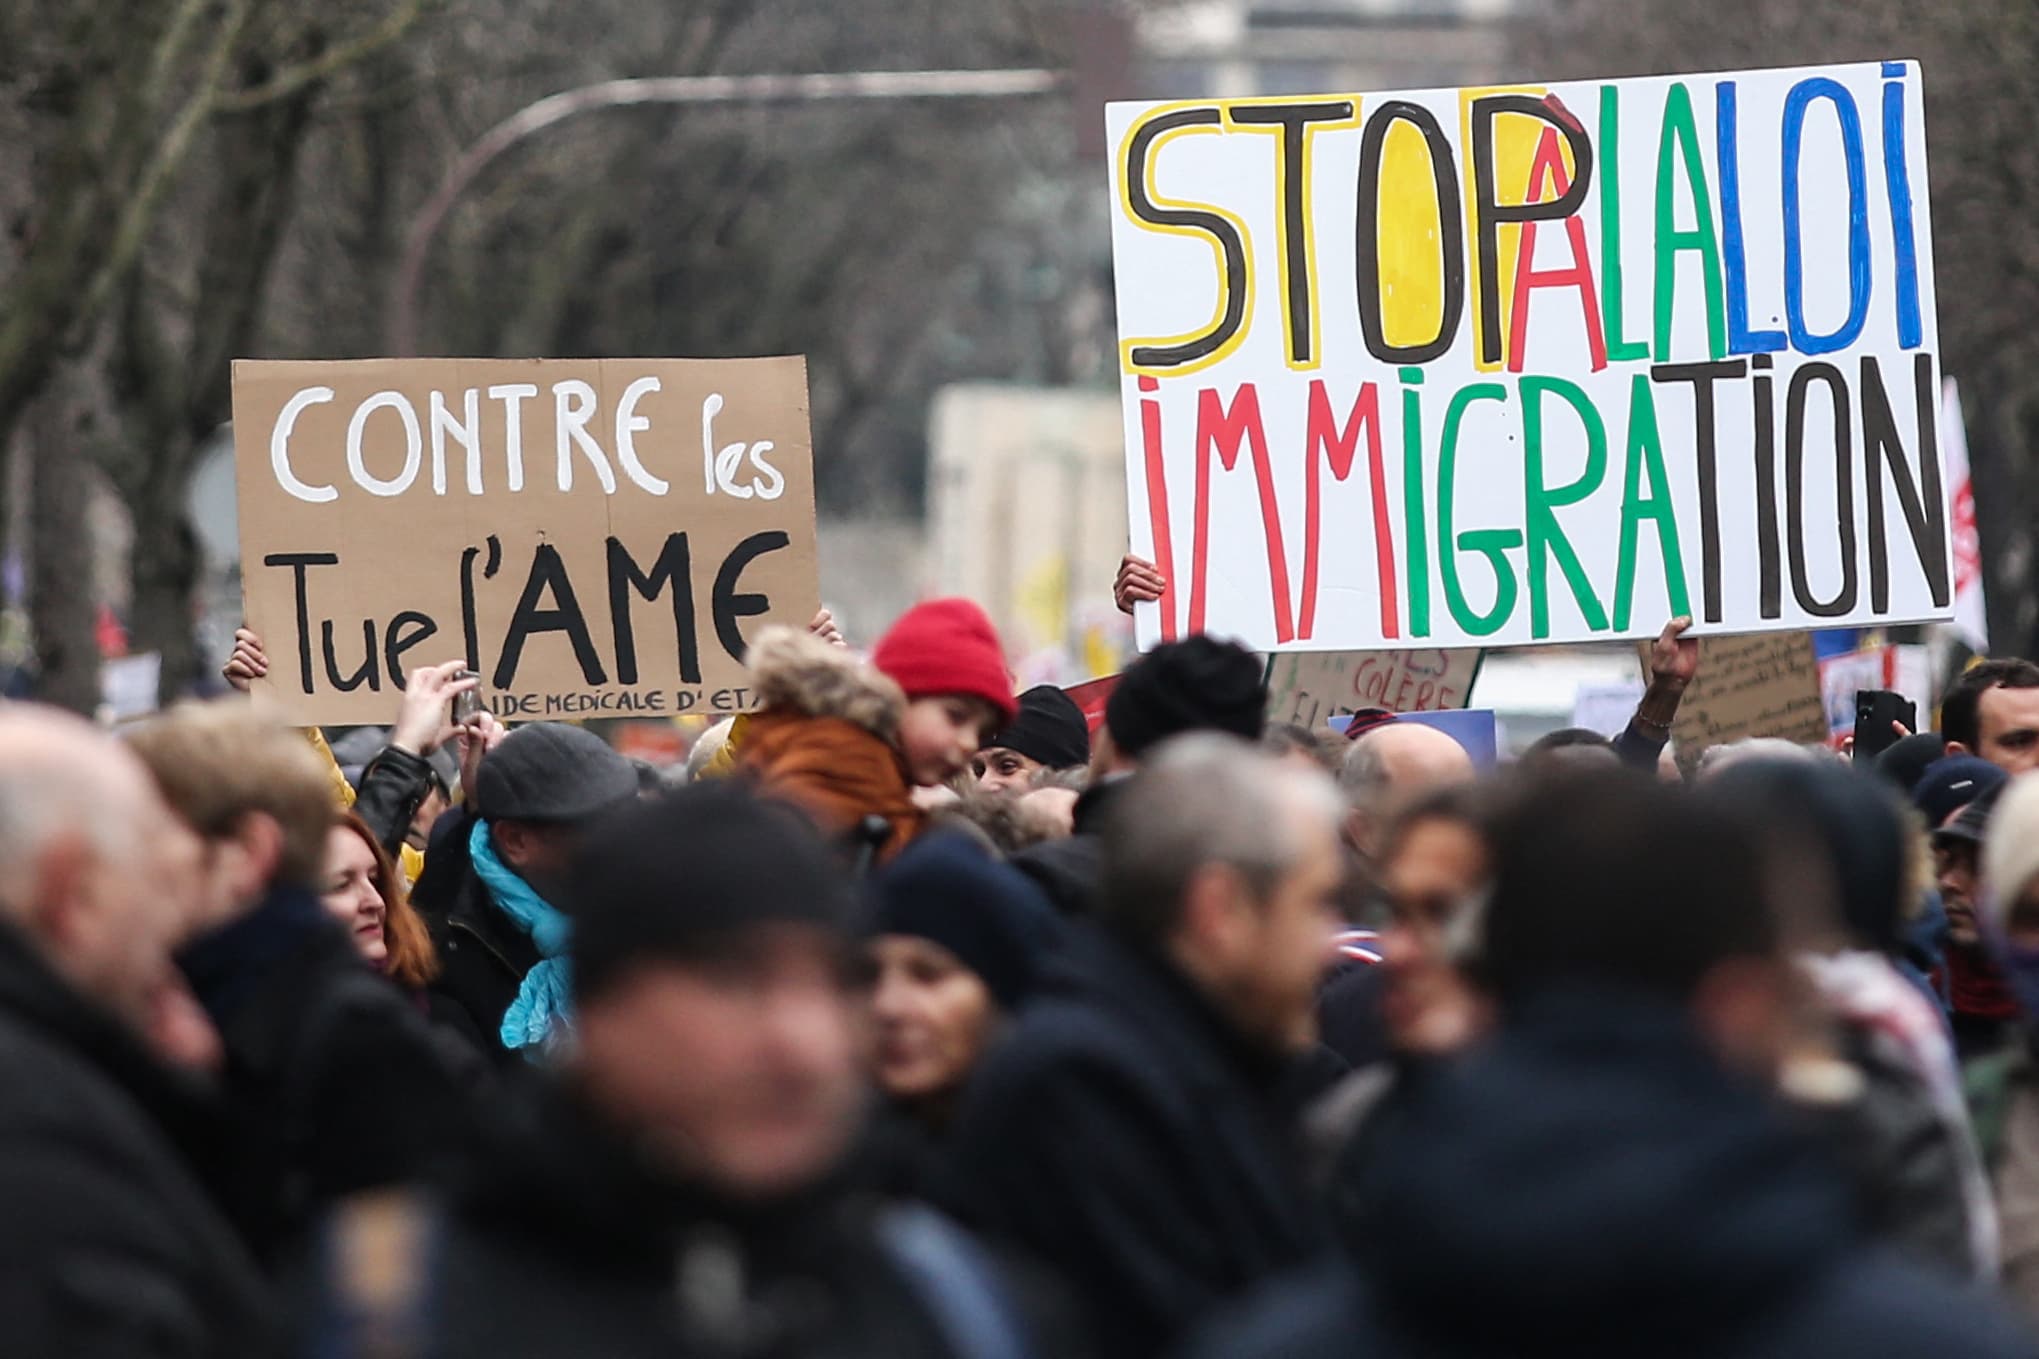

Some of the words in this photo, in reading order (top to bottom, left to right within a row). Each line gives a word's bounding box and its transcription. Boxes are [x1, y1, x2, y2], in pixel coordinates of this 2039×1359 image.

[1119, 87, 1592, 372] STOP
[1599, 83, 1725, 362] LA
[270, 377, 669, 502] CONTRE
[702, 394, 785, 499] les
[264, 552, 438, 694] Tue
